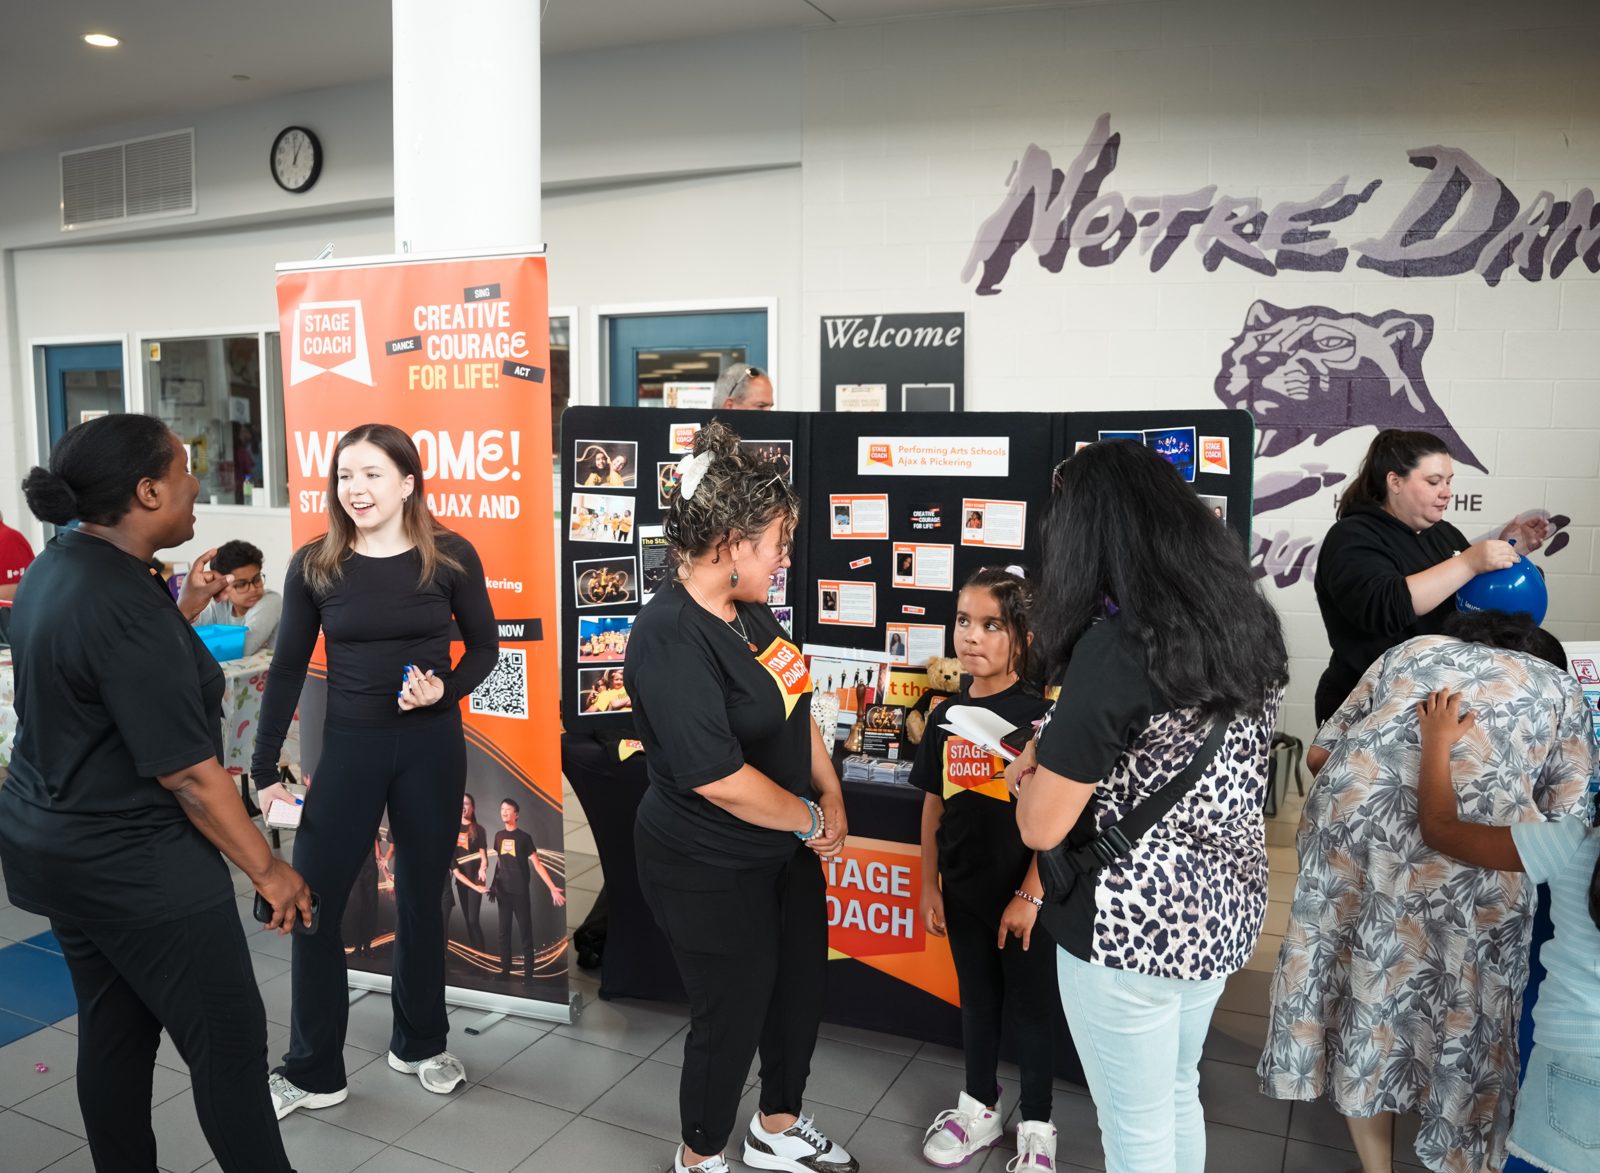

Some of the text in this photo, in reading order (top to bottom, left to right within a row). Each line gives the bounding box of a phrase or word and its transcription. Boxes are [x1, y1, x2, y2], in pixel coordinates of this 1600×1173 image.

[474, 287, 491, 299] SING
[304, 313, 350, 333] STAGE
[413, 301, 511, 331] CREATIVE
[824, 315, 963, 350] Welcome
[303, 335, 352, 355] COACH
[391, 339, 415, 352] DANCE
[426, 331, 530, 361] COURAGE
[408, 363, 499, 390] FOR LIFE!
[513, 365, 531, 378] ACT
[898, 445, 1007, 457] Performing Arts Schools
[1205, 450, 1221, 459] COACH
[898, 456, 973, 469] Ajax & Pickering
[427, 494, 473, 518] AJAX
[478, 495, 521, 520] AND
[485, 577, 523, 593] kering
[497, 624, 525, 637] NOW
[767, 645, 796, 672] STAGE
[782, 658, 807, 688] COACH
[949, 762, 990, 777] COACH
[822, 856, 911, 898] TAGE
[826, 895, 914, 939] OACH
